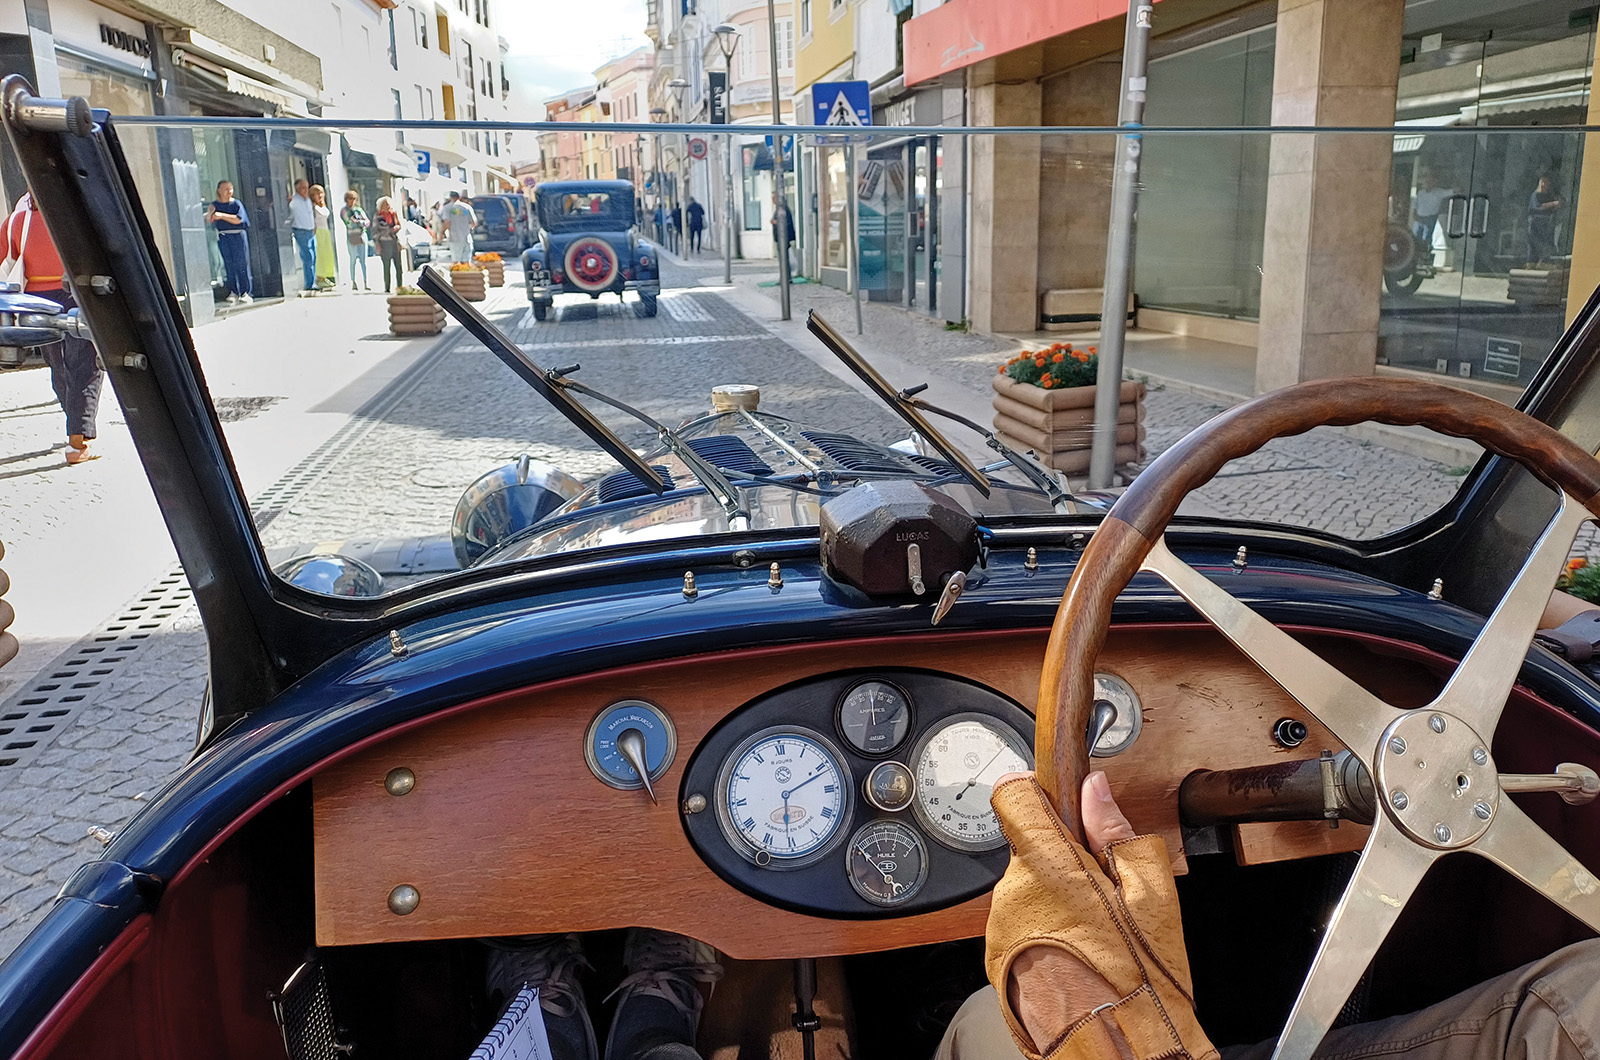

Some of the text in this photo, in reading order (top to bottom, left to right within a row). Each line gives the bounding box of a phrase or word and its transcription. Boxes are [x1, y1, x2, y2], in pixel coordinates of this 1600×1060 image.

[896, 531, 930, 542] LUCAS
[941, 813, 952, 821] 40
[947, 805, 972, 820] FABRIQUE
[958, 822, 968, 831] 35
[976, 823, 986, 831] 30
